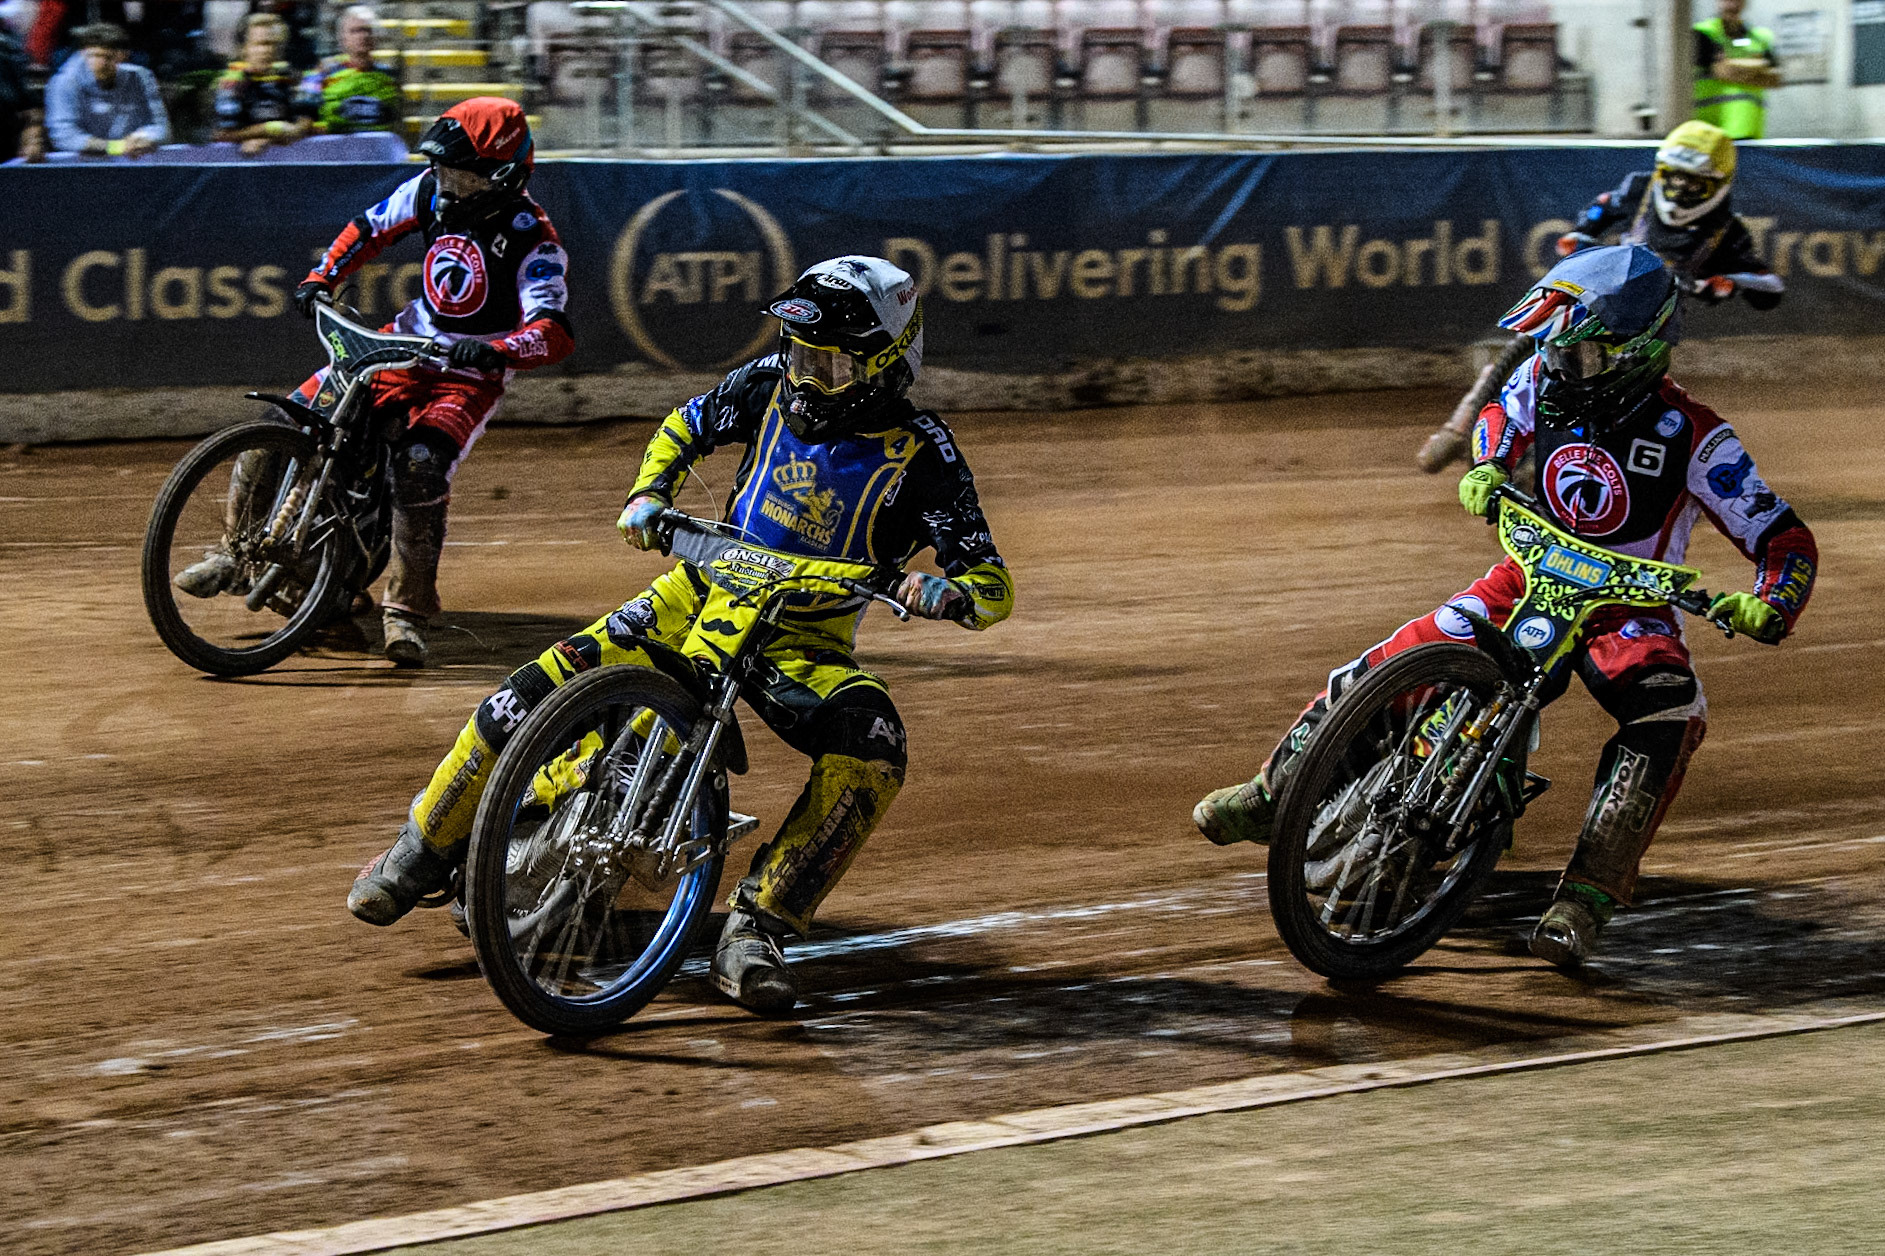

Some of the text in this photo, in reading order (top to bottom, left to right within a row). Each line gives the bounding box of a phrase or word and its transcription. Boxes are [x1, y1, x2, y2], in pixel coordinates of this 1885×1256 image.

[61, 247, 288, 322] Class
[641, 251, 762, 303] ATPI
[886, 232, 1262, 312] Delivering
[1283, 219, 1499, 290] World
[1553, 450, 1580, 469] BELLE
[1602, 463, 1622, 496] COLTS
[1632, 444, 1661, 471] 6
[761, 499, 832, 545] MONARCHS
[1521, 625, 1548, 641] ATPI
